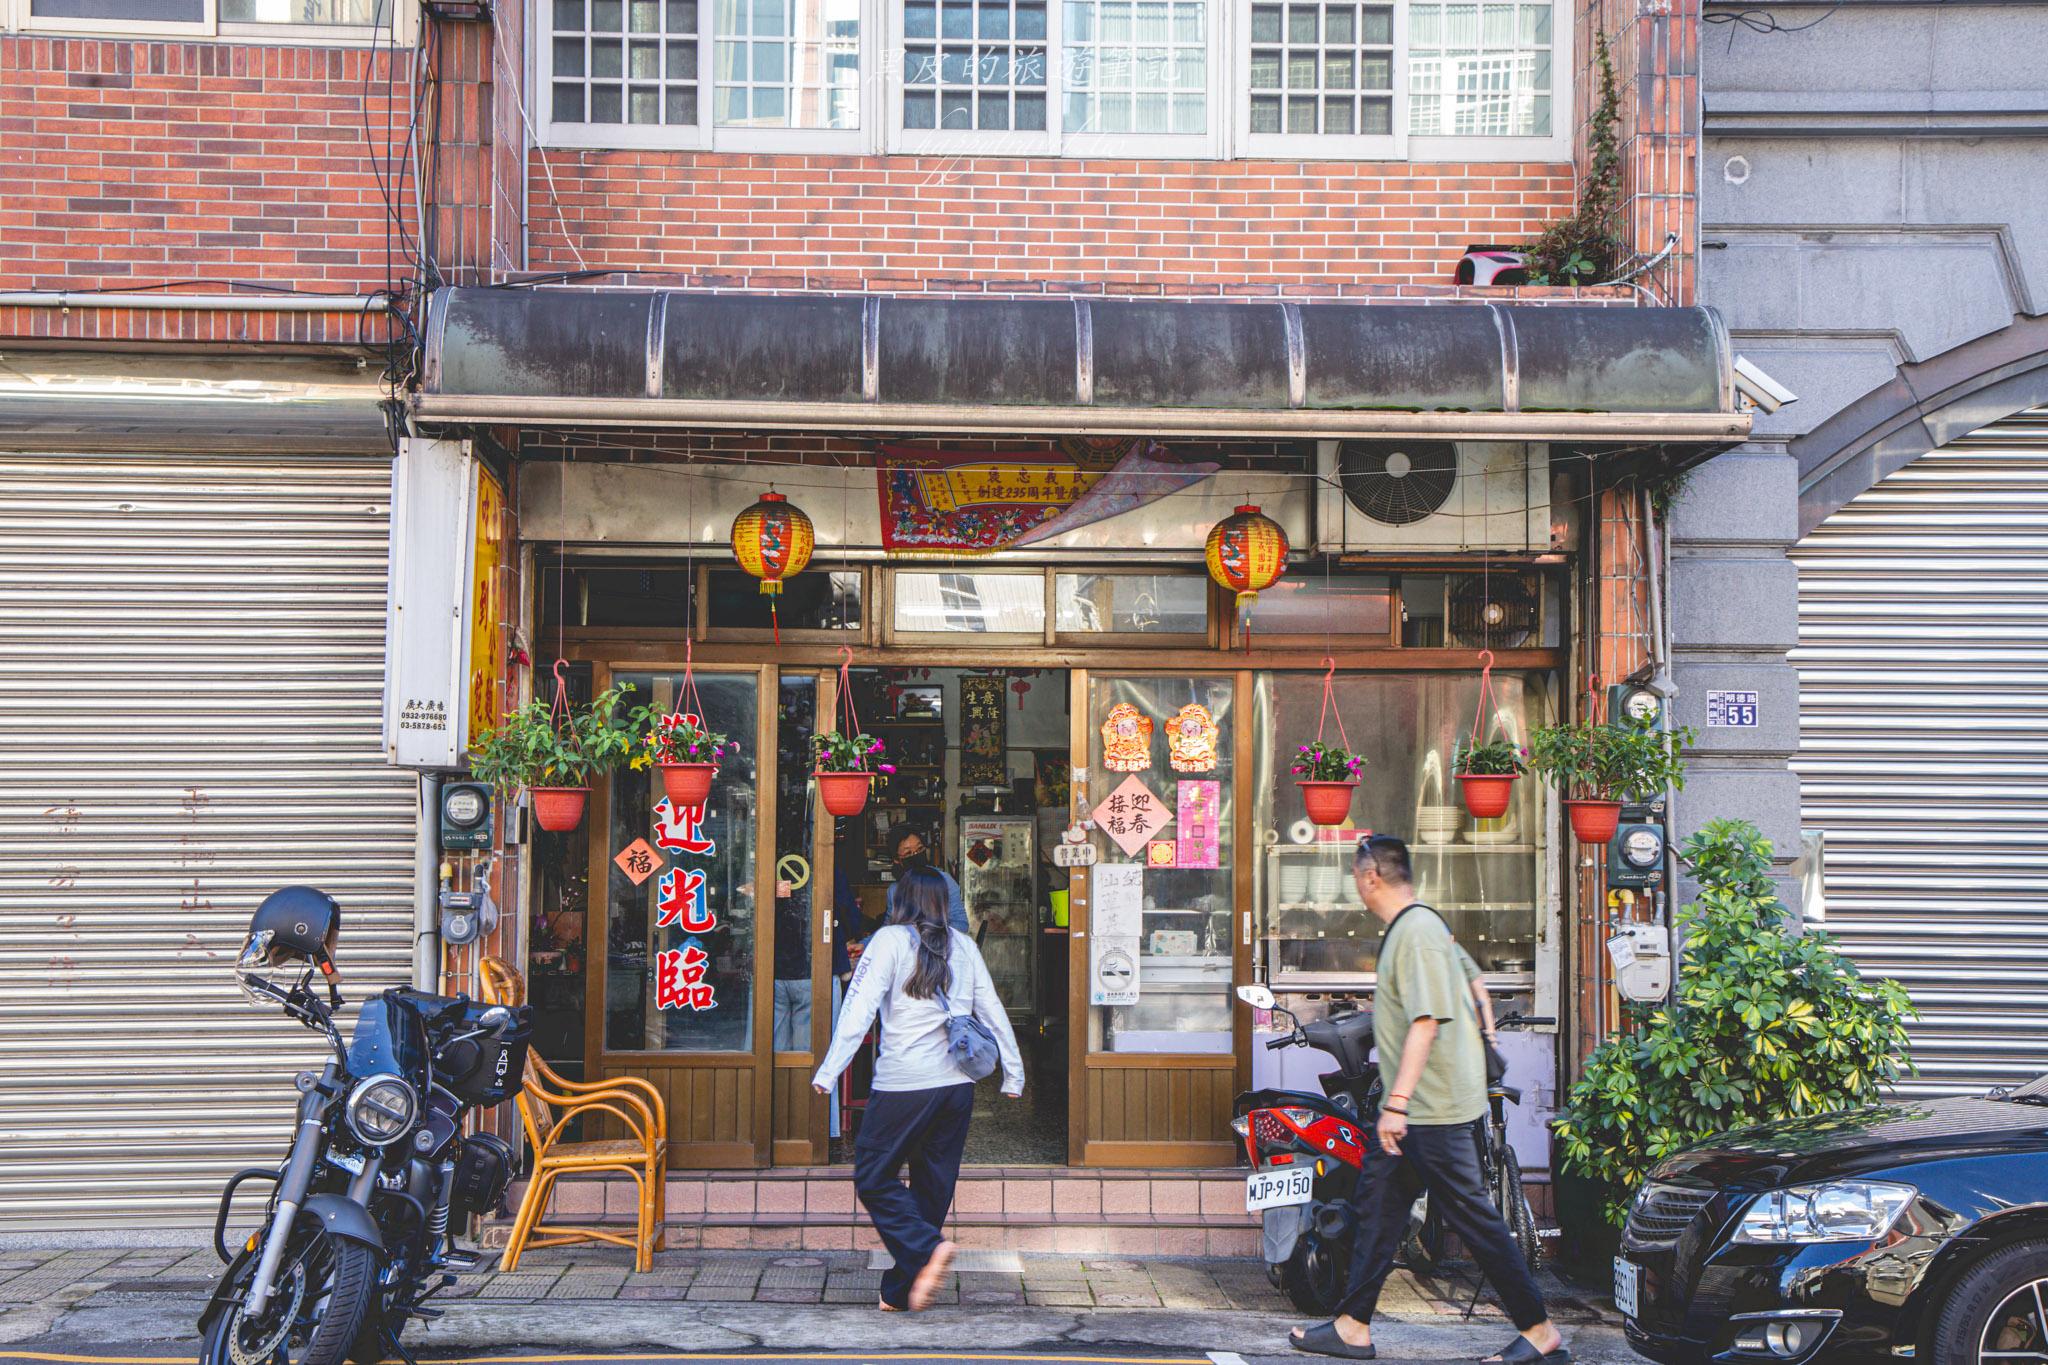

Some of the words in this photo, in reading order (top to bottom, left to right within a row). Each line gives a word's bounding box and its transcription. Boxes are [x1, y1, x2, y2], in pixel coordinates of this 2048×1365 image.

[1728, 706, 1753, 725] 55
[627, 849, 652, 874] 福
[853, 957, 872, 987] new
